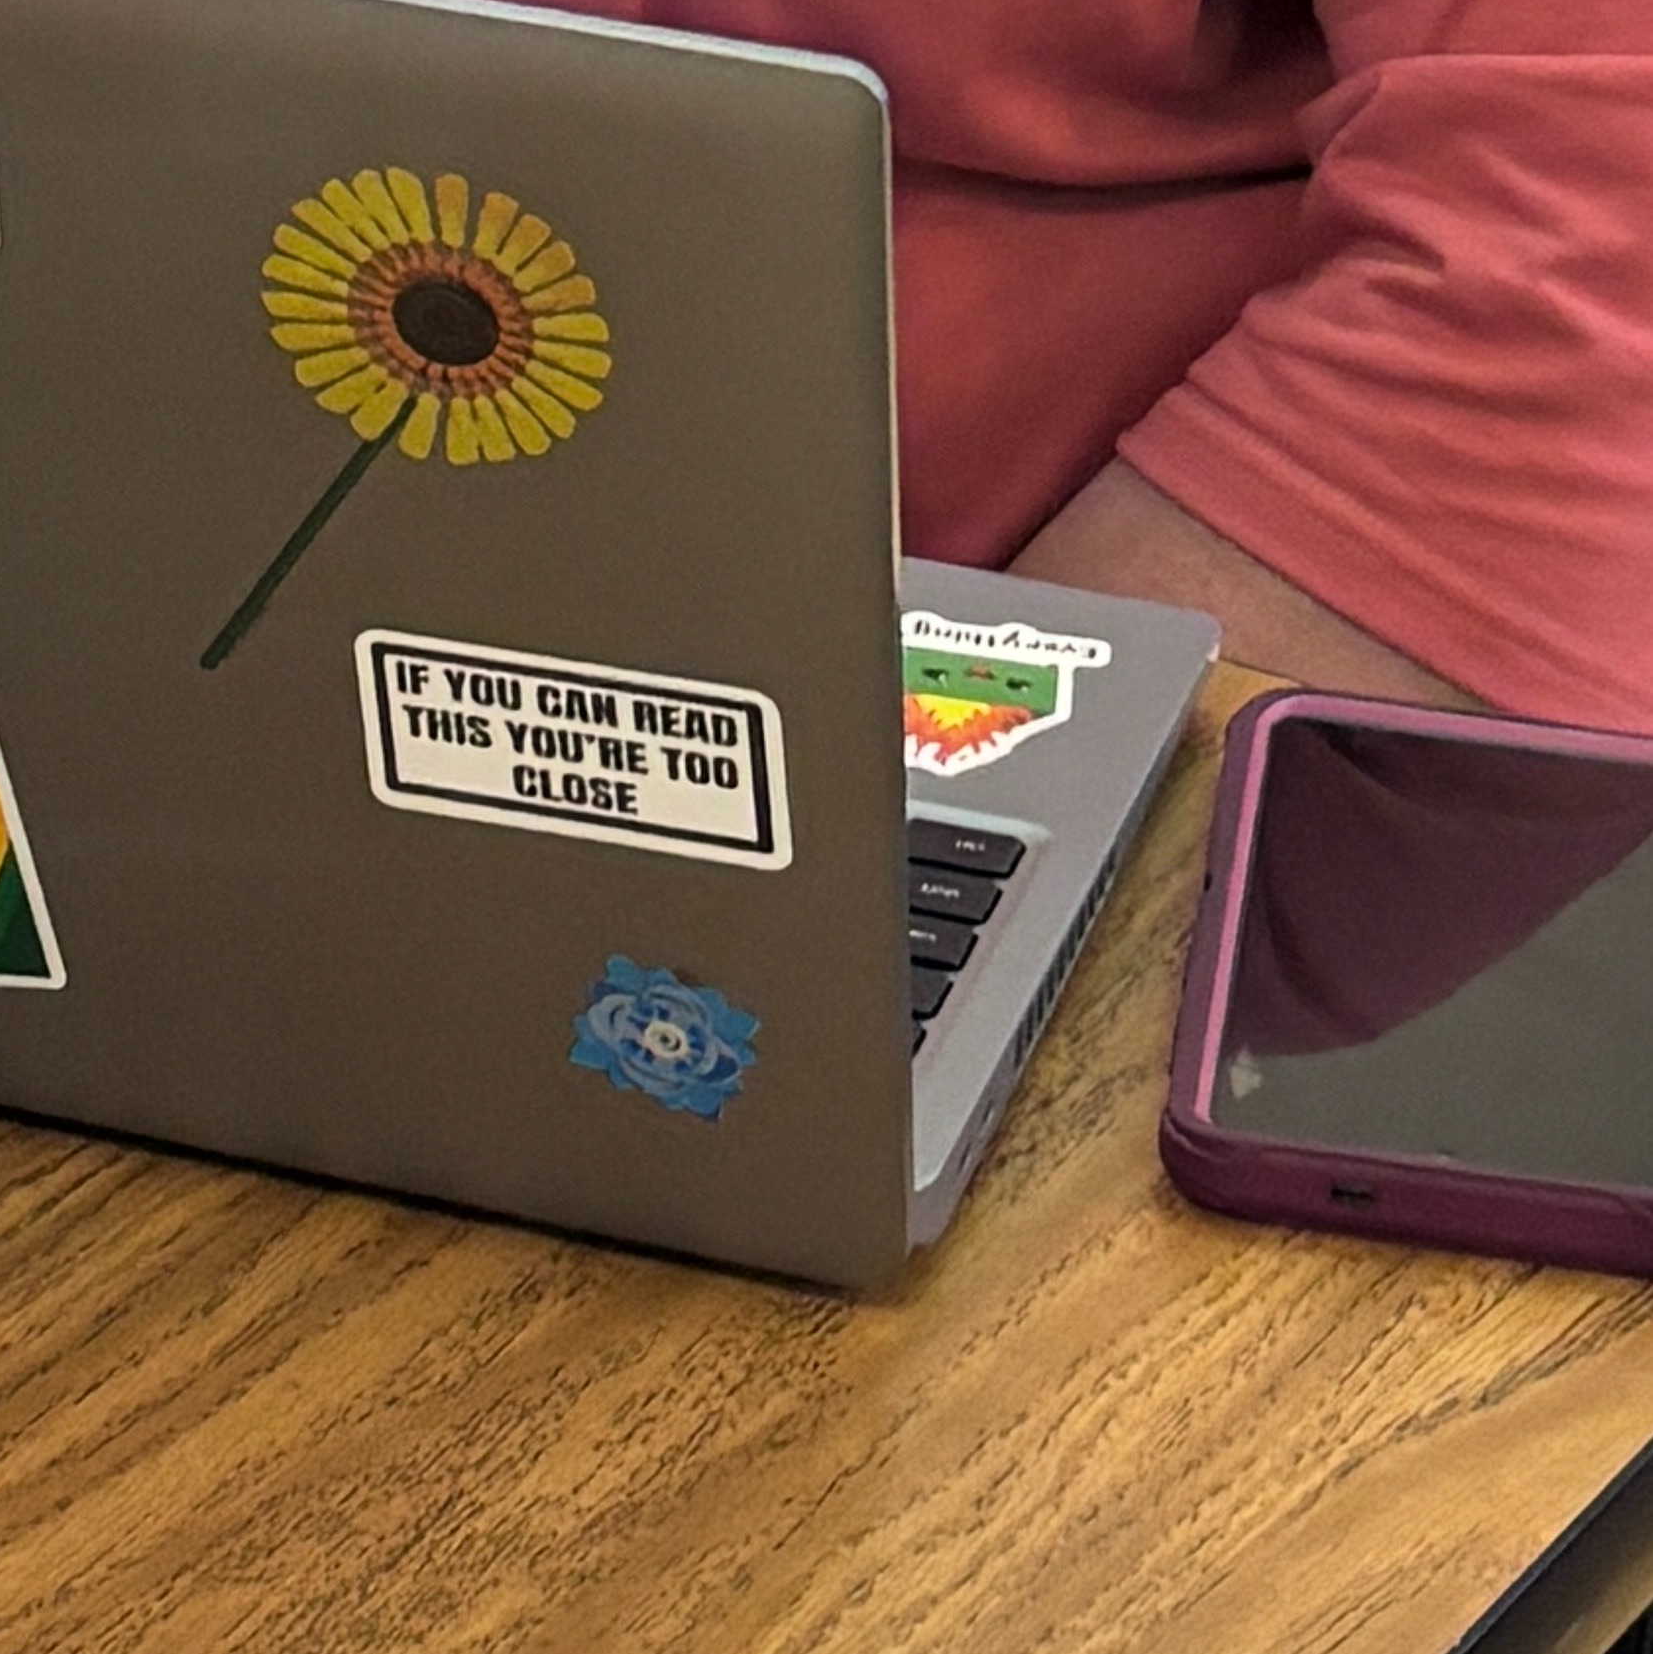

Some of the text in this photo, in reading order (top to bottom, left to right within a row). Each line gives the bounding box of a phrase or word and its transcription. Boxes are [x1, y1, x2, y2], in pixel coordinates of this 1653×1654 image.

[395, 660, 739, 748] IF YOU CAN READ
[402, 704, 740, 791] THIS YOU'RE TOO
[512, 764, 640, 816] CLOSE
